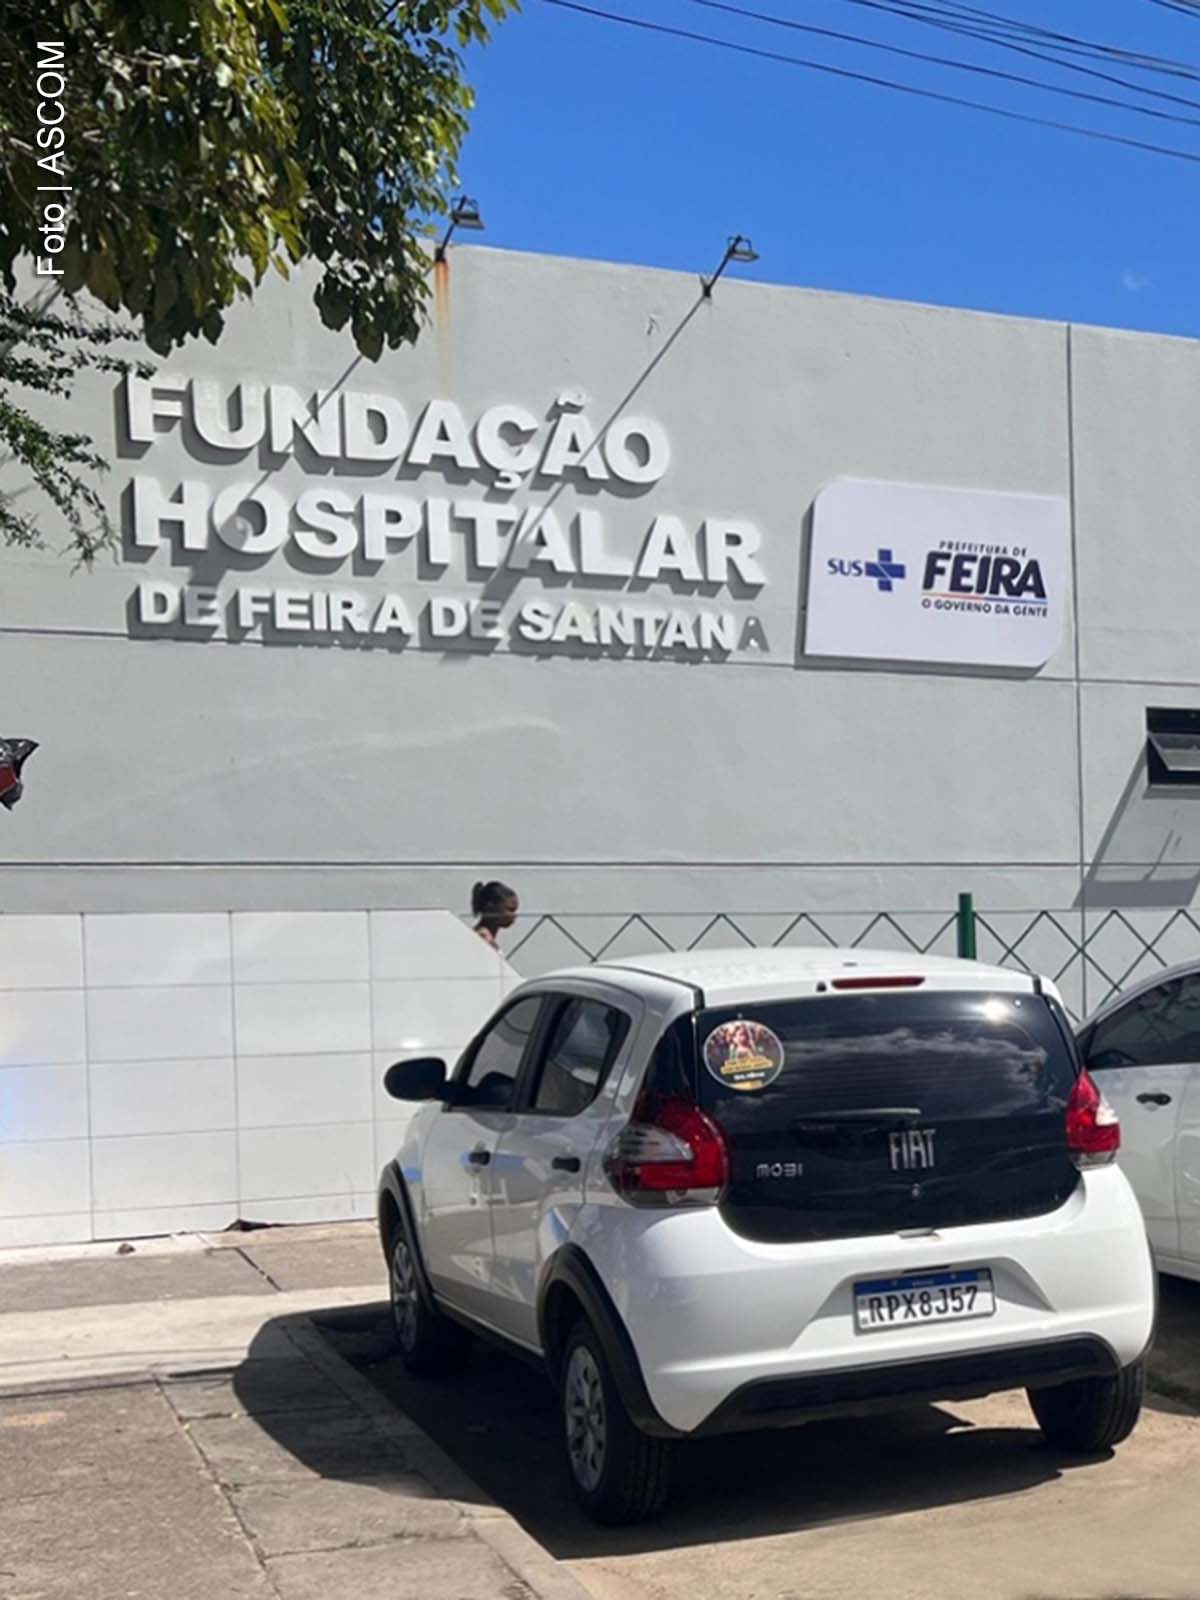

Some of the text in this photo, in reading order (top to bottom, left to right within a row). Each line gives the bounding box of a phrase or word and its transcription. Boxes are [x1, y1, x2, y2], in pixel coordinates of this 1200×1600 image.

[127, 374, 671, 490] FUNDAÇÃO
[132, 476, 768, 585] HOSPITALAR
[939, 540, 1027, 557] PREFEITURA DE
[827, 557, 863, 577] SUS
[922, 551, 1047, 599] FEIRA
[138, 581, 222, 627] DE
[237, 586, 414, 636] FEIRA
[429, 598, 505, 639] DE
[921, 598, 1048, 618] O GOVERNO DA GENTE
[888, 1129, 937, 1170] FIAT
[869, 1284, 978, 1323] RPX8J57
